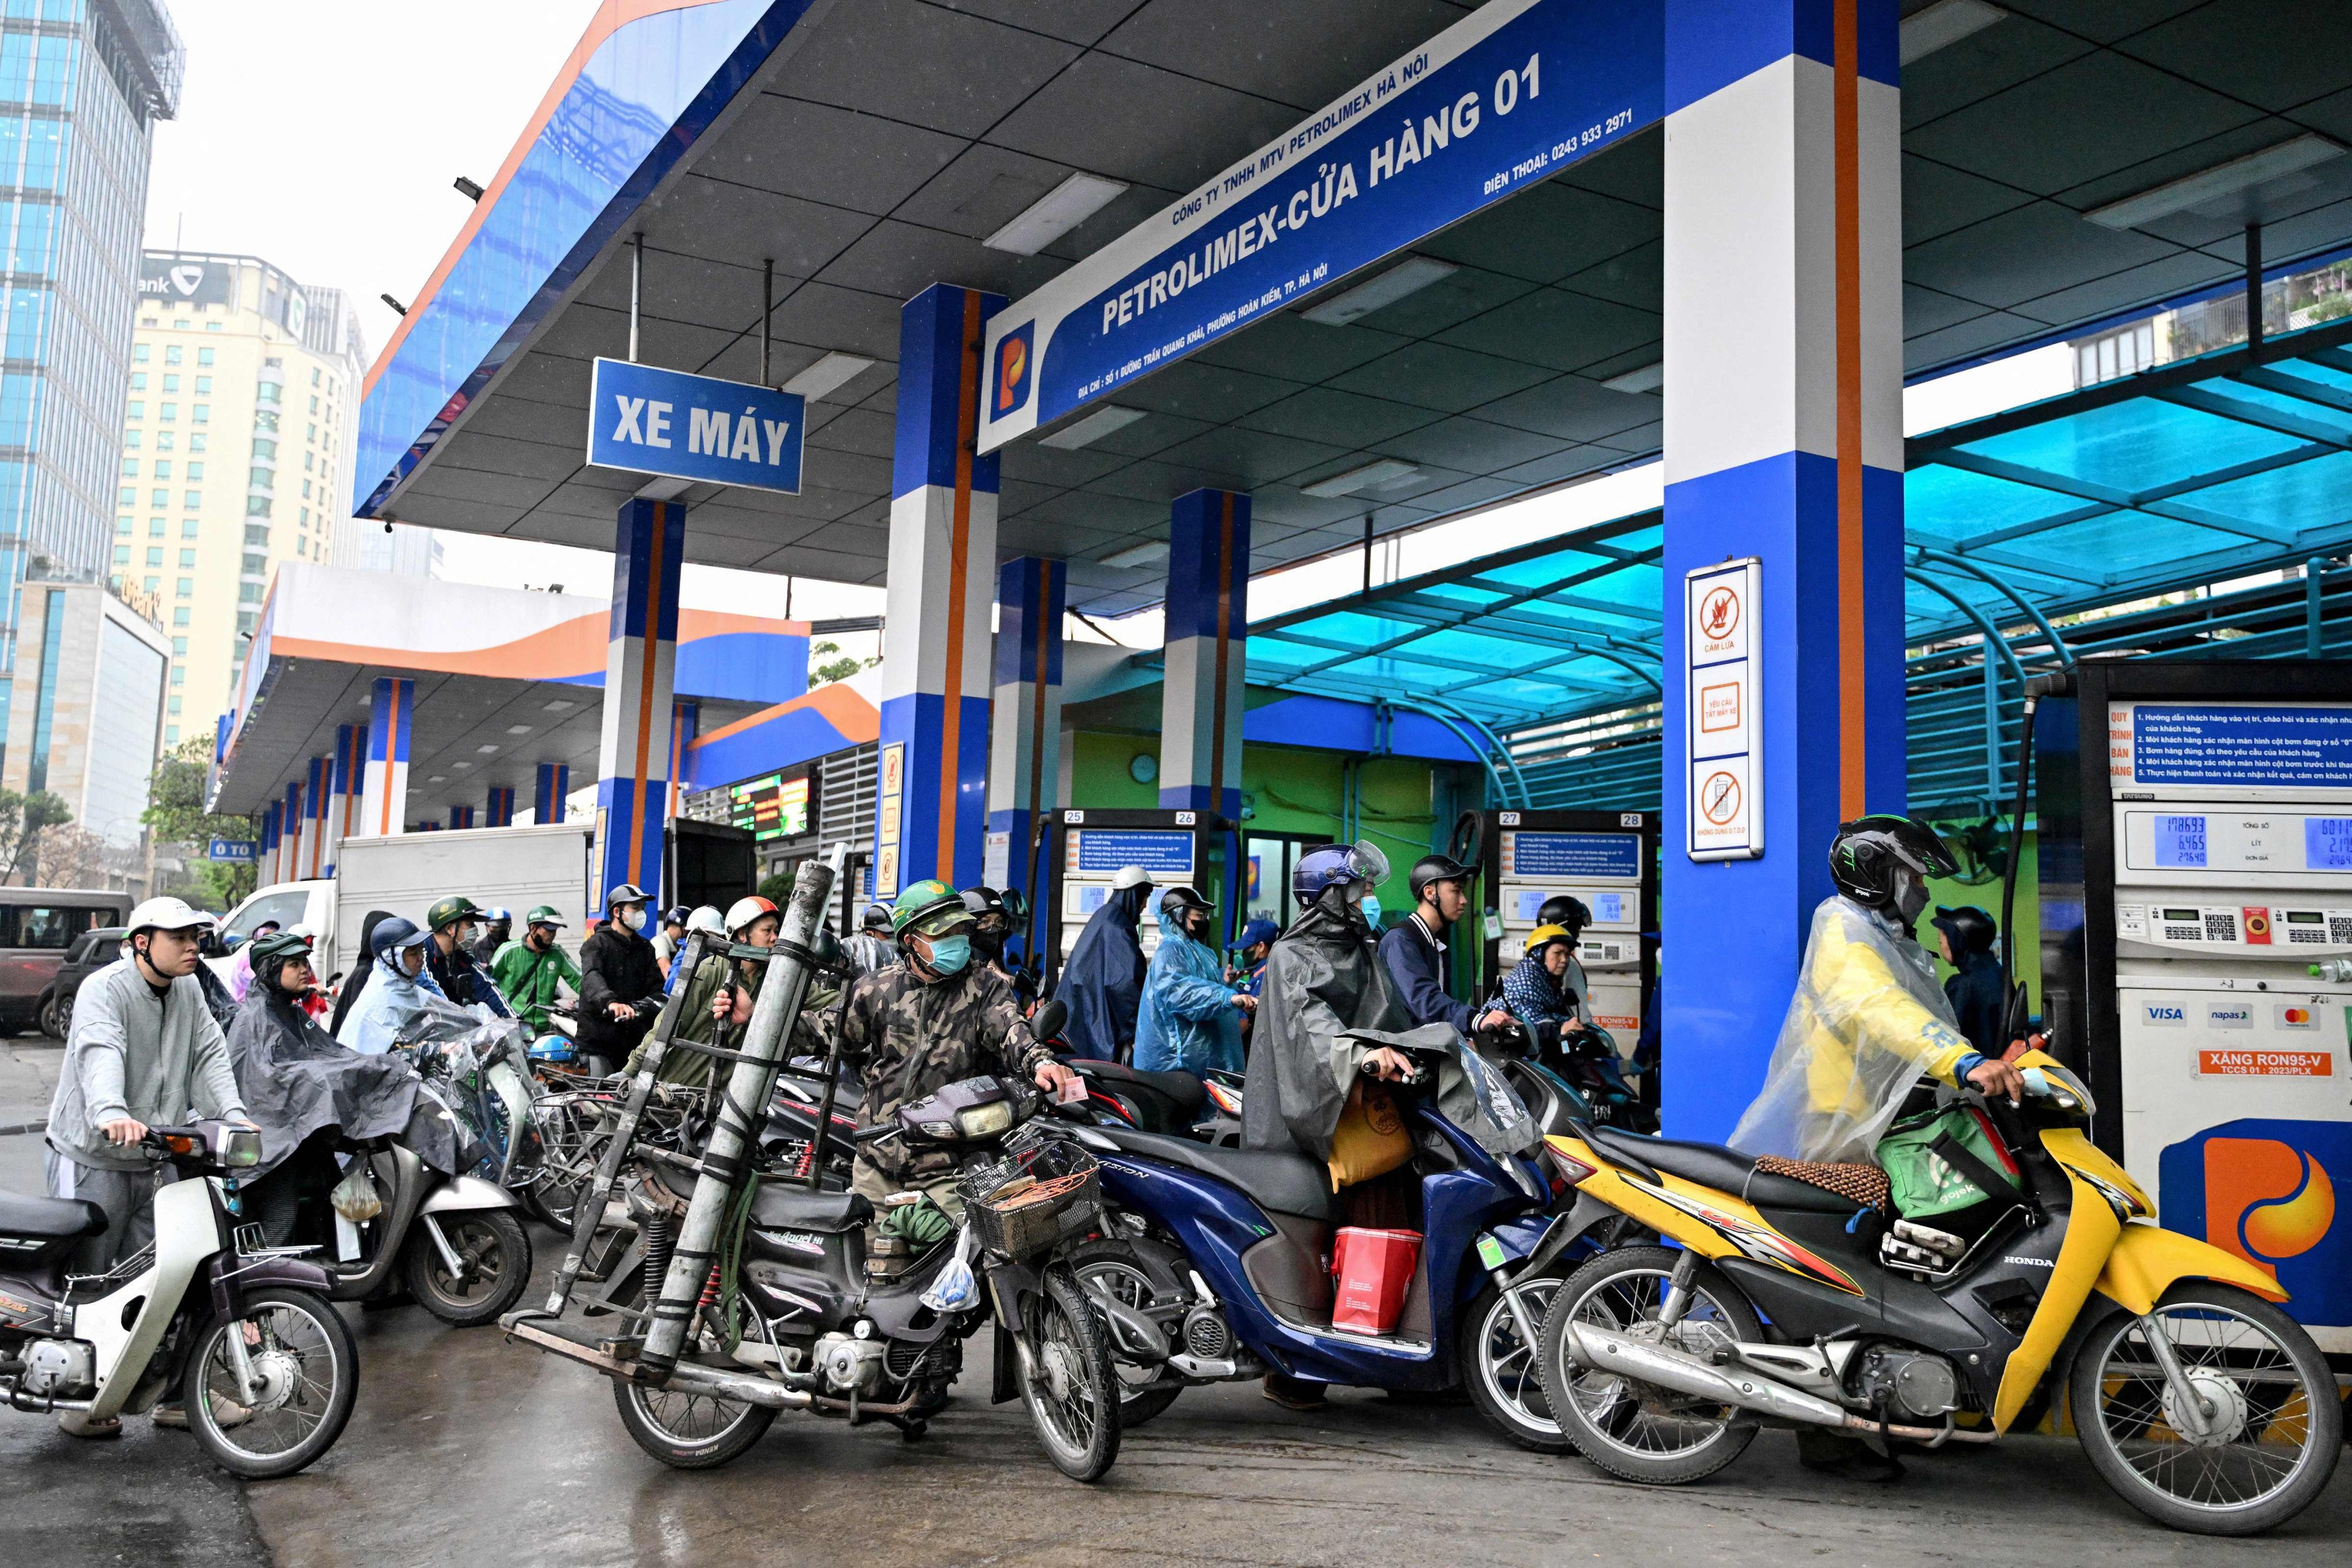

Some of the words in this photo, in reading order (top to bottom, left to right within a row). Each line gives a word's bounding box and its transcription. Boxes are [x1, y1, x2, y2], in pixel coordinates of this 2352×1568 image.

[1172, 198, 1202, 225] CÔNG
[1206, 186, 1219, 205] TY
[1223, 164, 1254, 194] TNHH
[1260, 145, 1284, 173] MTV
[1290, 90, 1371, 154] PETROLIMEX
[1377, 71, 1396, 99] HÀ
[1404, 53, 1428, 84] NỘI
[1484, 171, 1508, 195] ĐIỆN
[1512, 152, 1547, 180] THOẠI:
[1552, 137, 1577, 161] 0243
[1582, 125, 1601, 146] 933
[1606, 108, 1632, 134] 2971
[1103, 163, 1358, 335] PETROLIMEX-CỬA
[1370, 90, 1481, 188] HÀNG
[1494, 53, 1541, 115] 01
[1079, 388, 1088, 400] ĐỊA
[1090, 376, 1100, 392] CHỈ
[1105, 370, 1114, 386] SỐ
[1115, 372, 1119, 380] 1
[1162, 337, 1185, 356] QUANG
[1207, 310, 1236, 334] PHƯỜNG
[1238, 300, 1258, 319] HOÀN
[1284, 281, 1296, 295] TP.
[1299, 271, 1310, 287] HÀ
[1314, 263, 1327, 280] NỘI
[612, 395, 673, 449] XE
[688, 407, 789, 466] MÁY
[2111, 712, 2127, 722] QUY
[2210, 715, 2227, 723] hàng
[2272, 737, 2283, 746] cột
[2303, 739, 2321, 747] đang
[2218, 759, 2235, 768] nhận
[2272, 760, 2284, 768] cột
[2247, 771, 2265, 779] nhận
[1068, 812, 1080, 821] 25
[1179, 813, 1192, 823] 26
[1503, 814, 1517, 824] 27
[1624, 815, 1639, 825] 28
[216, 843, 226, 855] Ô
[231, 844, 249, 855] TÔ
[1855, 888, 1870, 897] gojek
[2147, 1007, 2183, 1019] VISA
[2212, 1012, 2239, 1020] napas
[2211, 1052, 2253, 1065] XĂNG
[2257, 1053, 2320, 1065] RON95-V
[1940, 1184, 1975, 1204] gojek
[781, 1231, 813, 1243] Angel
[2004, 1256, 2054, 1267] HONDA
[696, 1444, 719, 1456] KENDA
